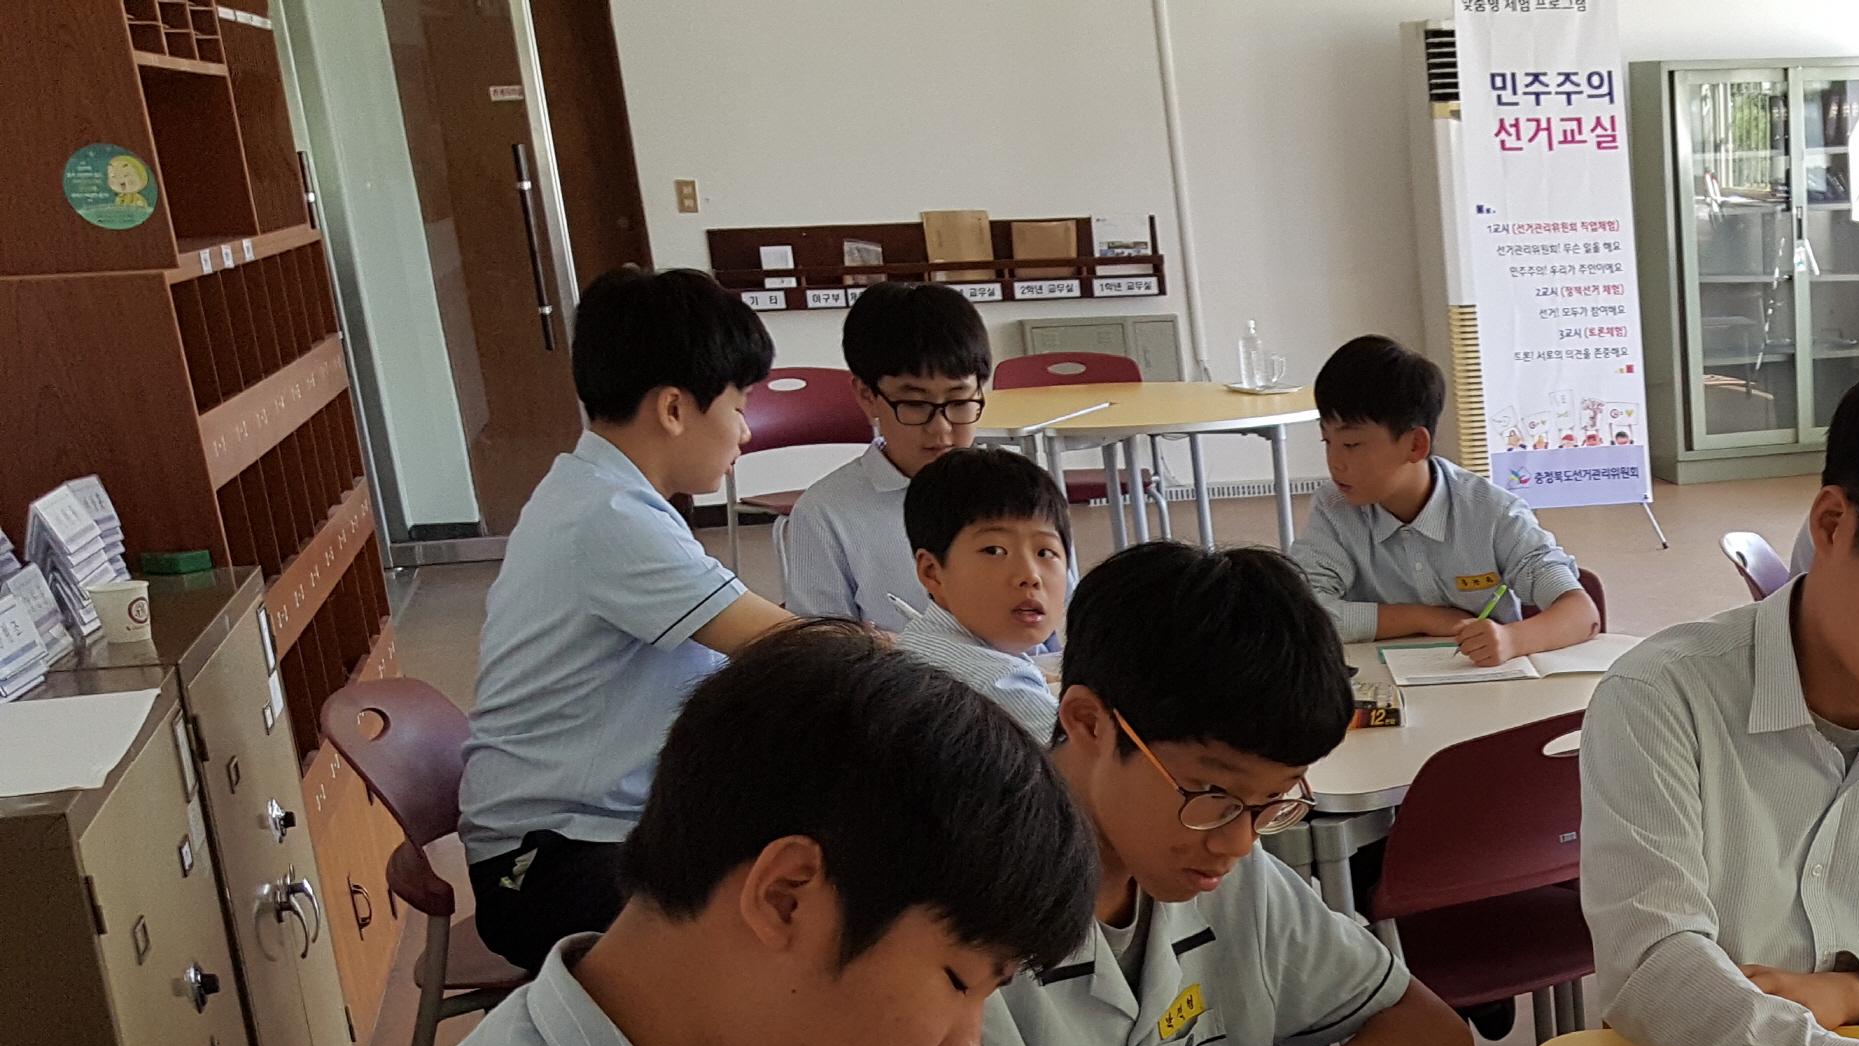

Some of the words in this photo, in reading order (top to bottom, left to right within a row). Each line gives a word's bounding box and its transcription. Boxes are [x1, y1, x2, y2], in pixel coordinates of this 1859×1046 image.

[1490, 70, 1615, 106] 민주주의
[1494, 115, 1619, 151] 선거교실
[1534, 466, 1640, 484] 충청북도선거관리위원회
[1371, 709, 1386, 726] 12
